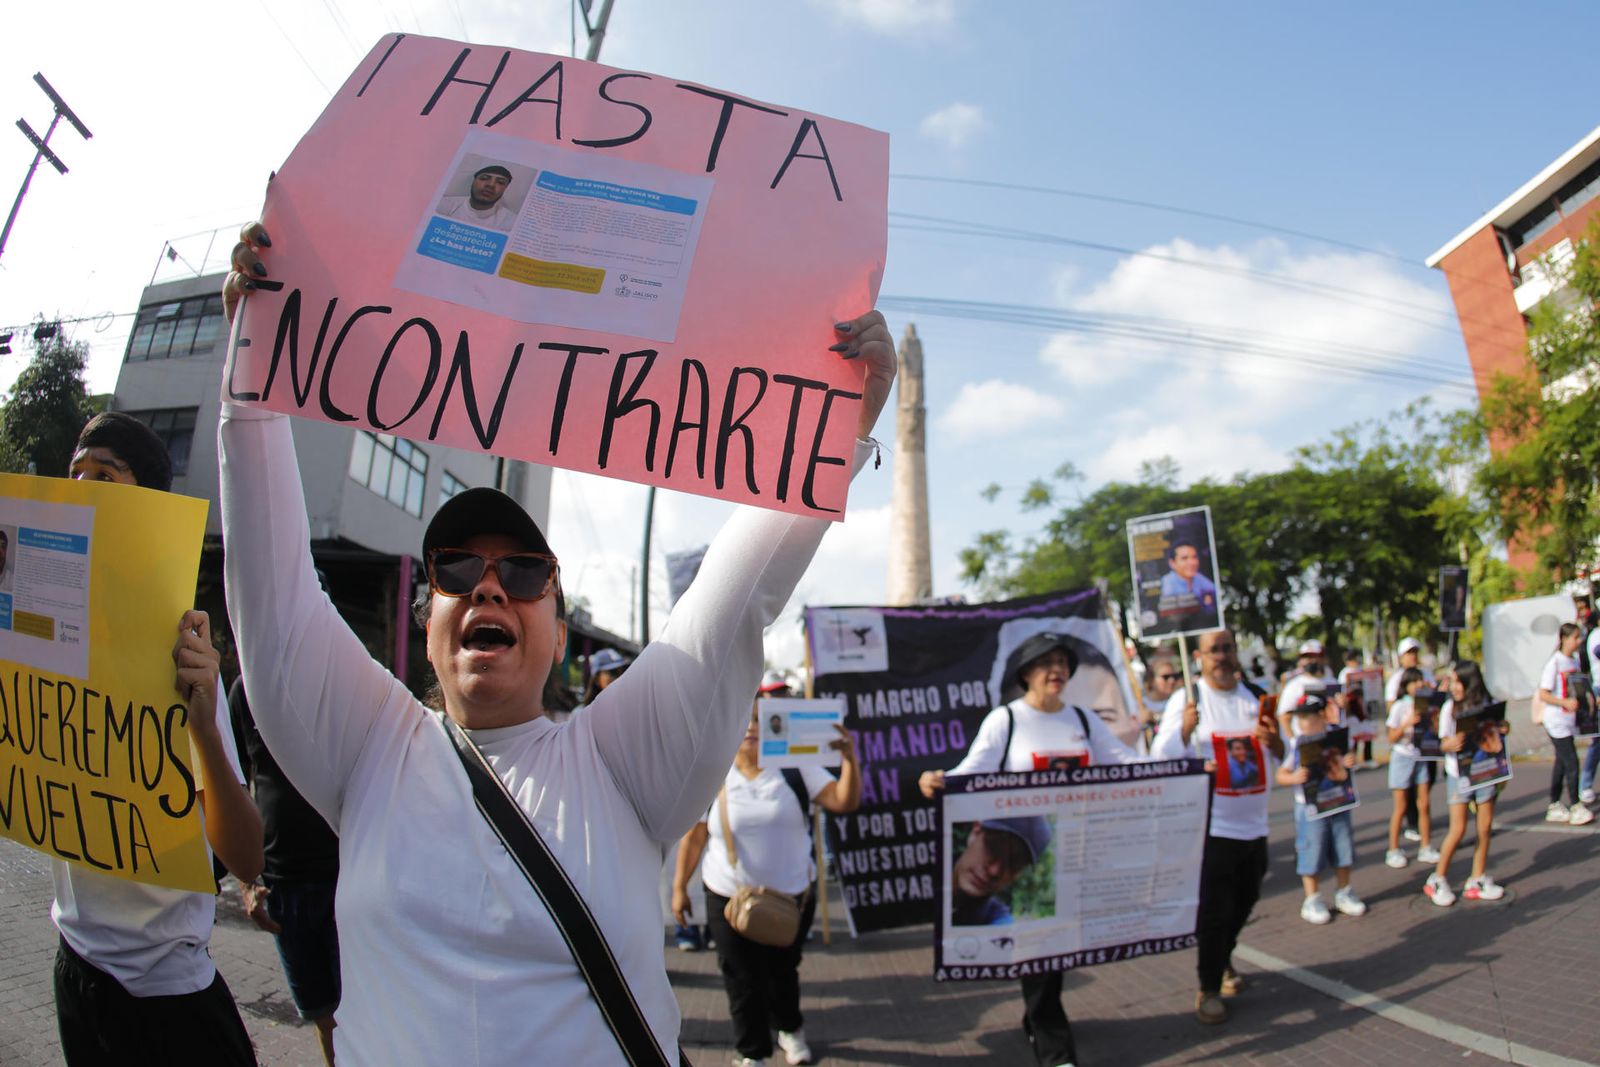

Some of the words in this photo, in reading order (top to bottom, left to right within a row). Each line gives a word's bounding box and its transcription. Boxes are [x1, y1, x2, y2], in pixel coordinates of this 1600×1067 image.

[420, 47, 842, 202] HASTA
[432, 227, 497, 250] desaparecida
[448, 223, 487, 240] Persona
[228, 279, 863, 513] ENCONTRARTE
[856, 686, 942, 719] MARCHO
[947, 680, 988, 709] POR
[1071, 766, 1130, 782] CARLOS
[1133, 760, 1190, 778] DANIEL?
[994, 796, 1051, 810] CARLOS
[1055, 791, 1106, 805] DANIEL
[1110, 786, 1163, 800] CUEVAS
[834, 816, 848, 842] Y
[857, 812, 895, 839] POR
[935, 951, 1107, 982] AGUASCALIENTES
[1124, 934, 1199, 960] JALISCO
